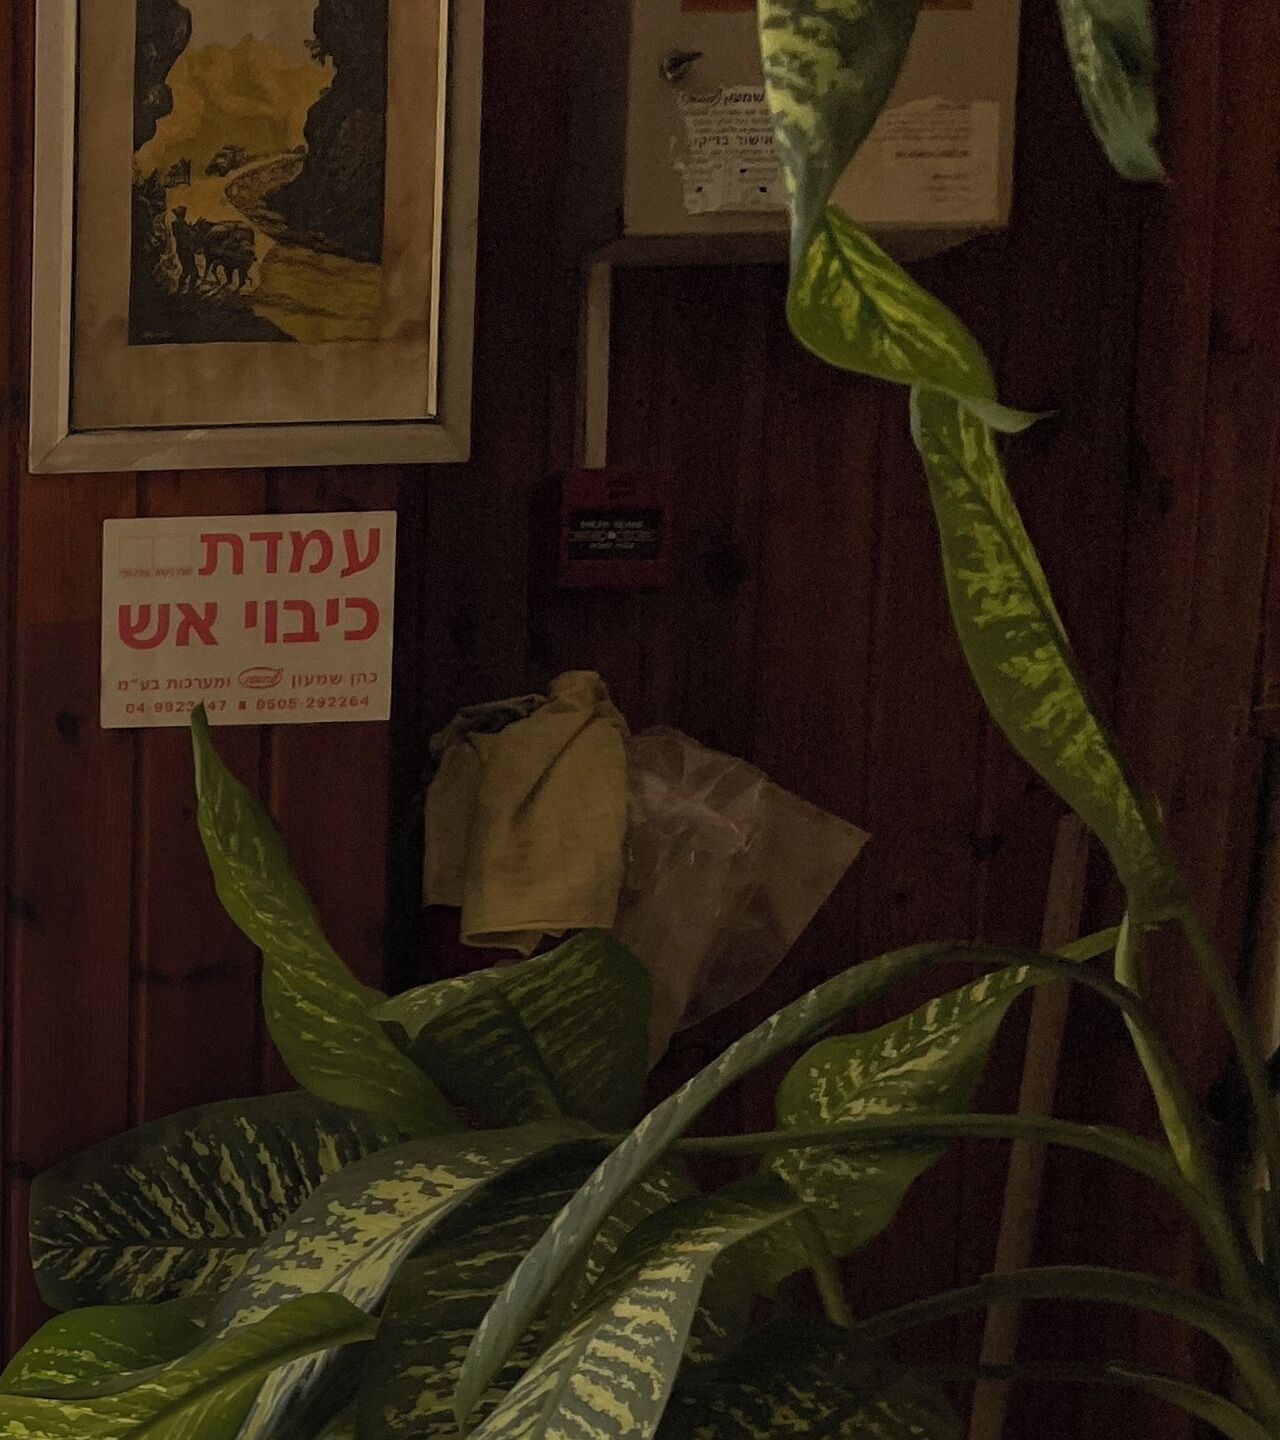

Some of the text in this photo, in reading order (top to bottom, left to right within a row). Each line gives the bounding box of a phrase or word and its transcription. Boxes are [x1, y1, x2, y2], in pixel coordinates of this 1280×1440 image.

[198, 528, 381, 578] עמדת
[117, 597, 380, 650] כיבוי אש
[166, 676, 231, 690] ומערכות
[291, 672, 343, 690] שמעון
[350, 672, 379, 687] כהן
